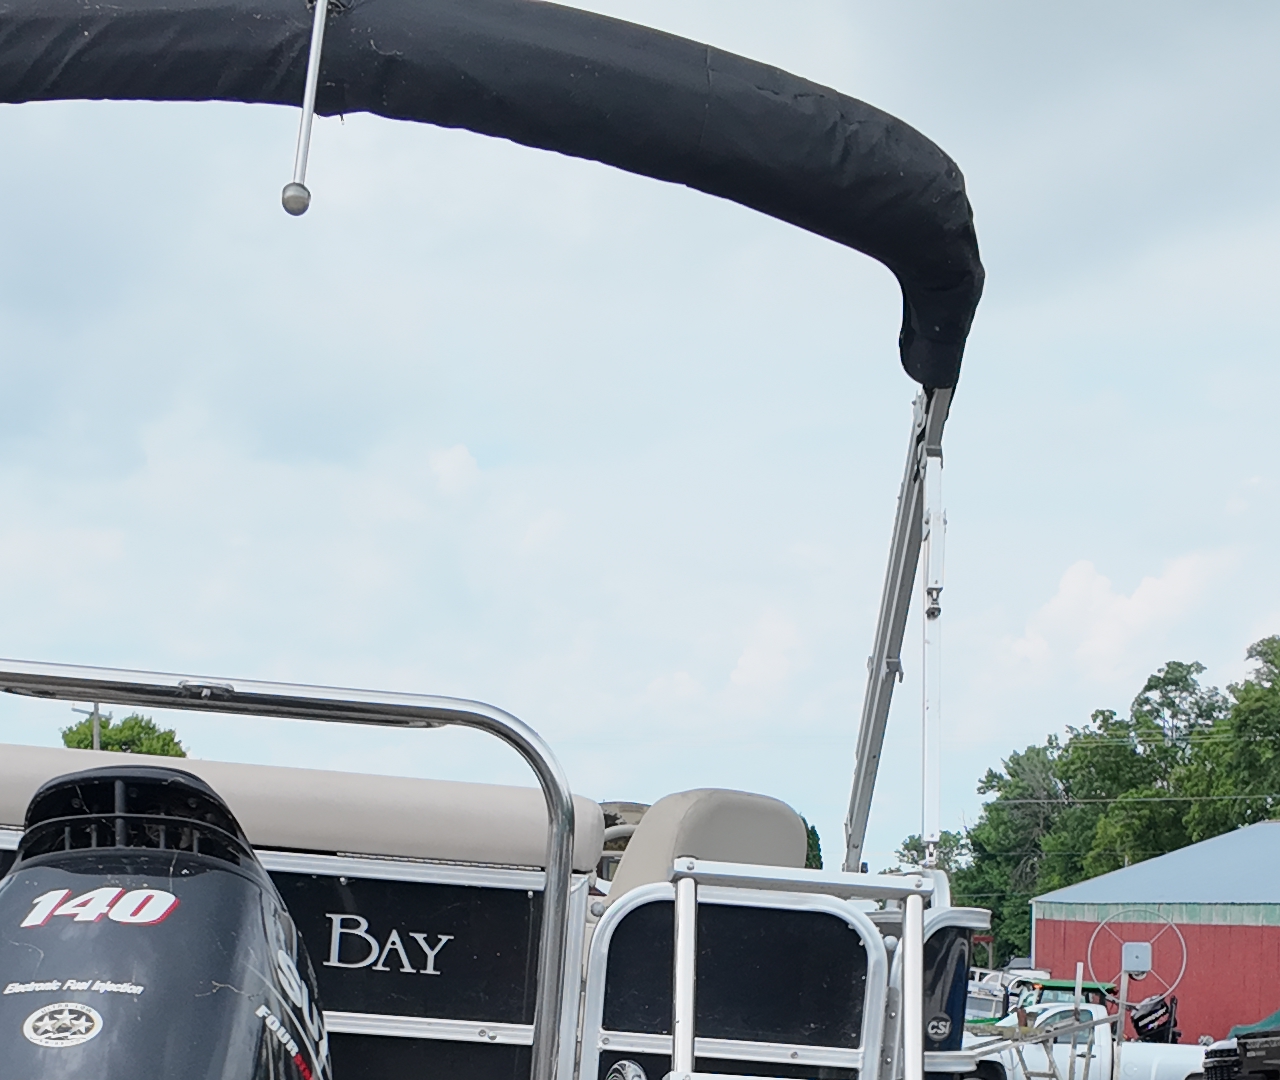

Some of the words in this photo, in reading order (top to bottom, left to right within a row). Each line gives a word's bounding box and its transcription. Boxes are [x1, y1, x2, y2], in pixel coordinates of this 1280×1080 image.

[20, 887, 180, 928] 140
[323, 913, 454, 975] BAY
[3, 979, 62, 994] Electronic
[62, 979, 92, 991] Fuel
[91, 980, 144, 994] Injection
